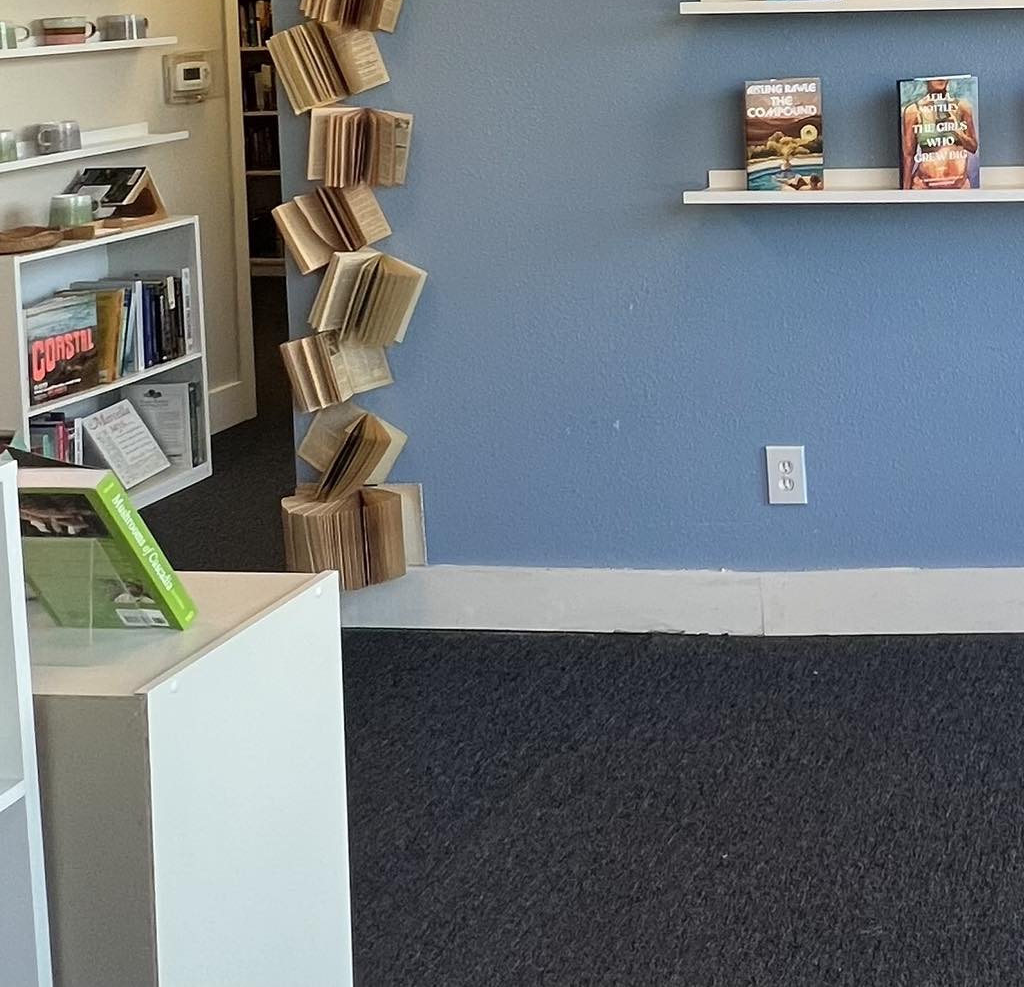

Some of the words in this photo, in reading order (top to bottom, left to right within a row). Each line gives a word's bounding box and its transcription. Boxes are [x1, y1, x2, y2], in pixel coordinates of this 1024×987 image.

[770, 96, 793, 107] THE
[746, 105, 817, 118] COMPOUND
[912, 124, 934, 134] THE
[936, 121, 968, 132] GIRLS
[926, 136, 955, 147] WHO
[914, 152, 946, 163] GREW
[949, 150, 968, 160] BIG
[32, 328, 94, 382] COASTAL
[112, 493, 146, 546] Mushrooms
[142, 545, 154, 556] of
[148, 552, 173, 591] Cascadia
